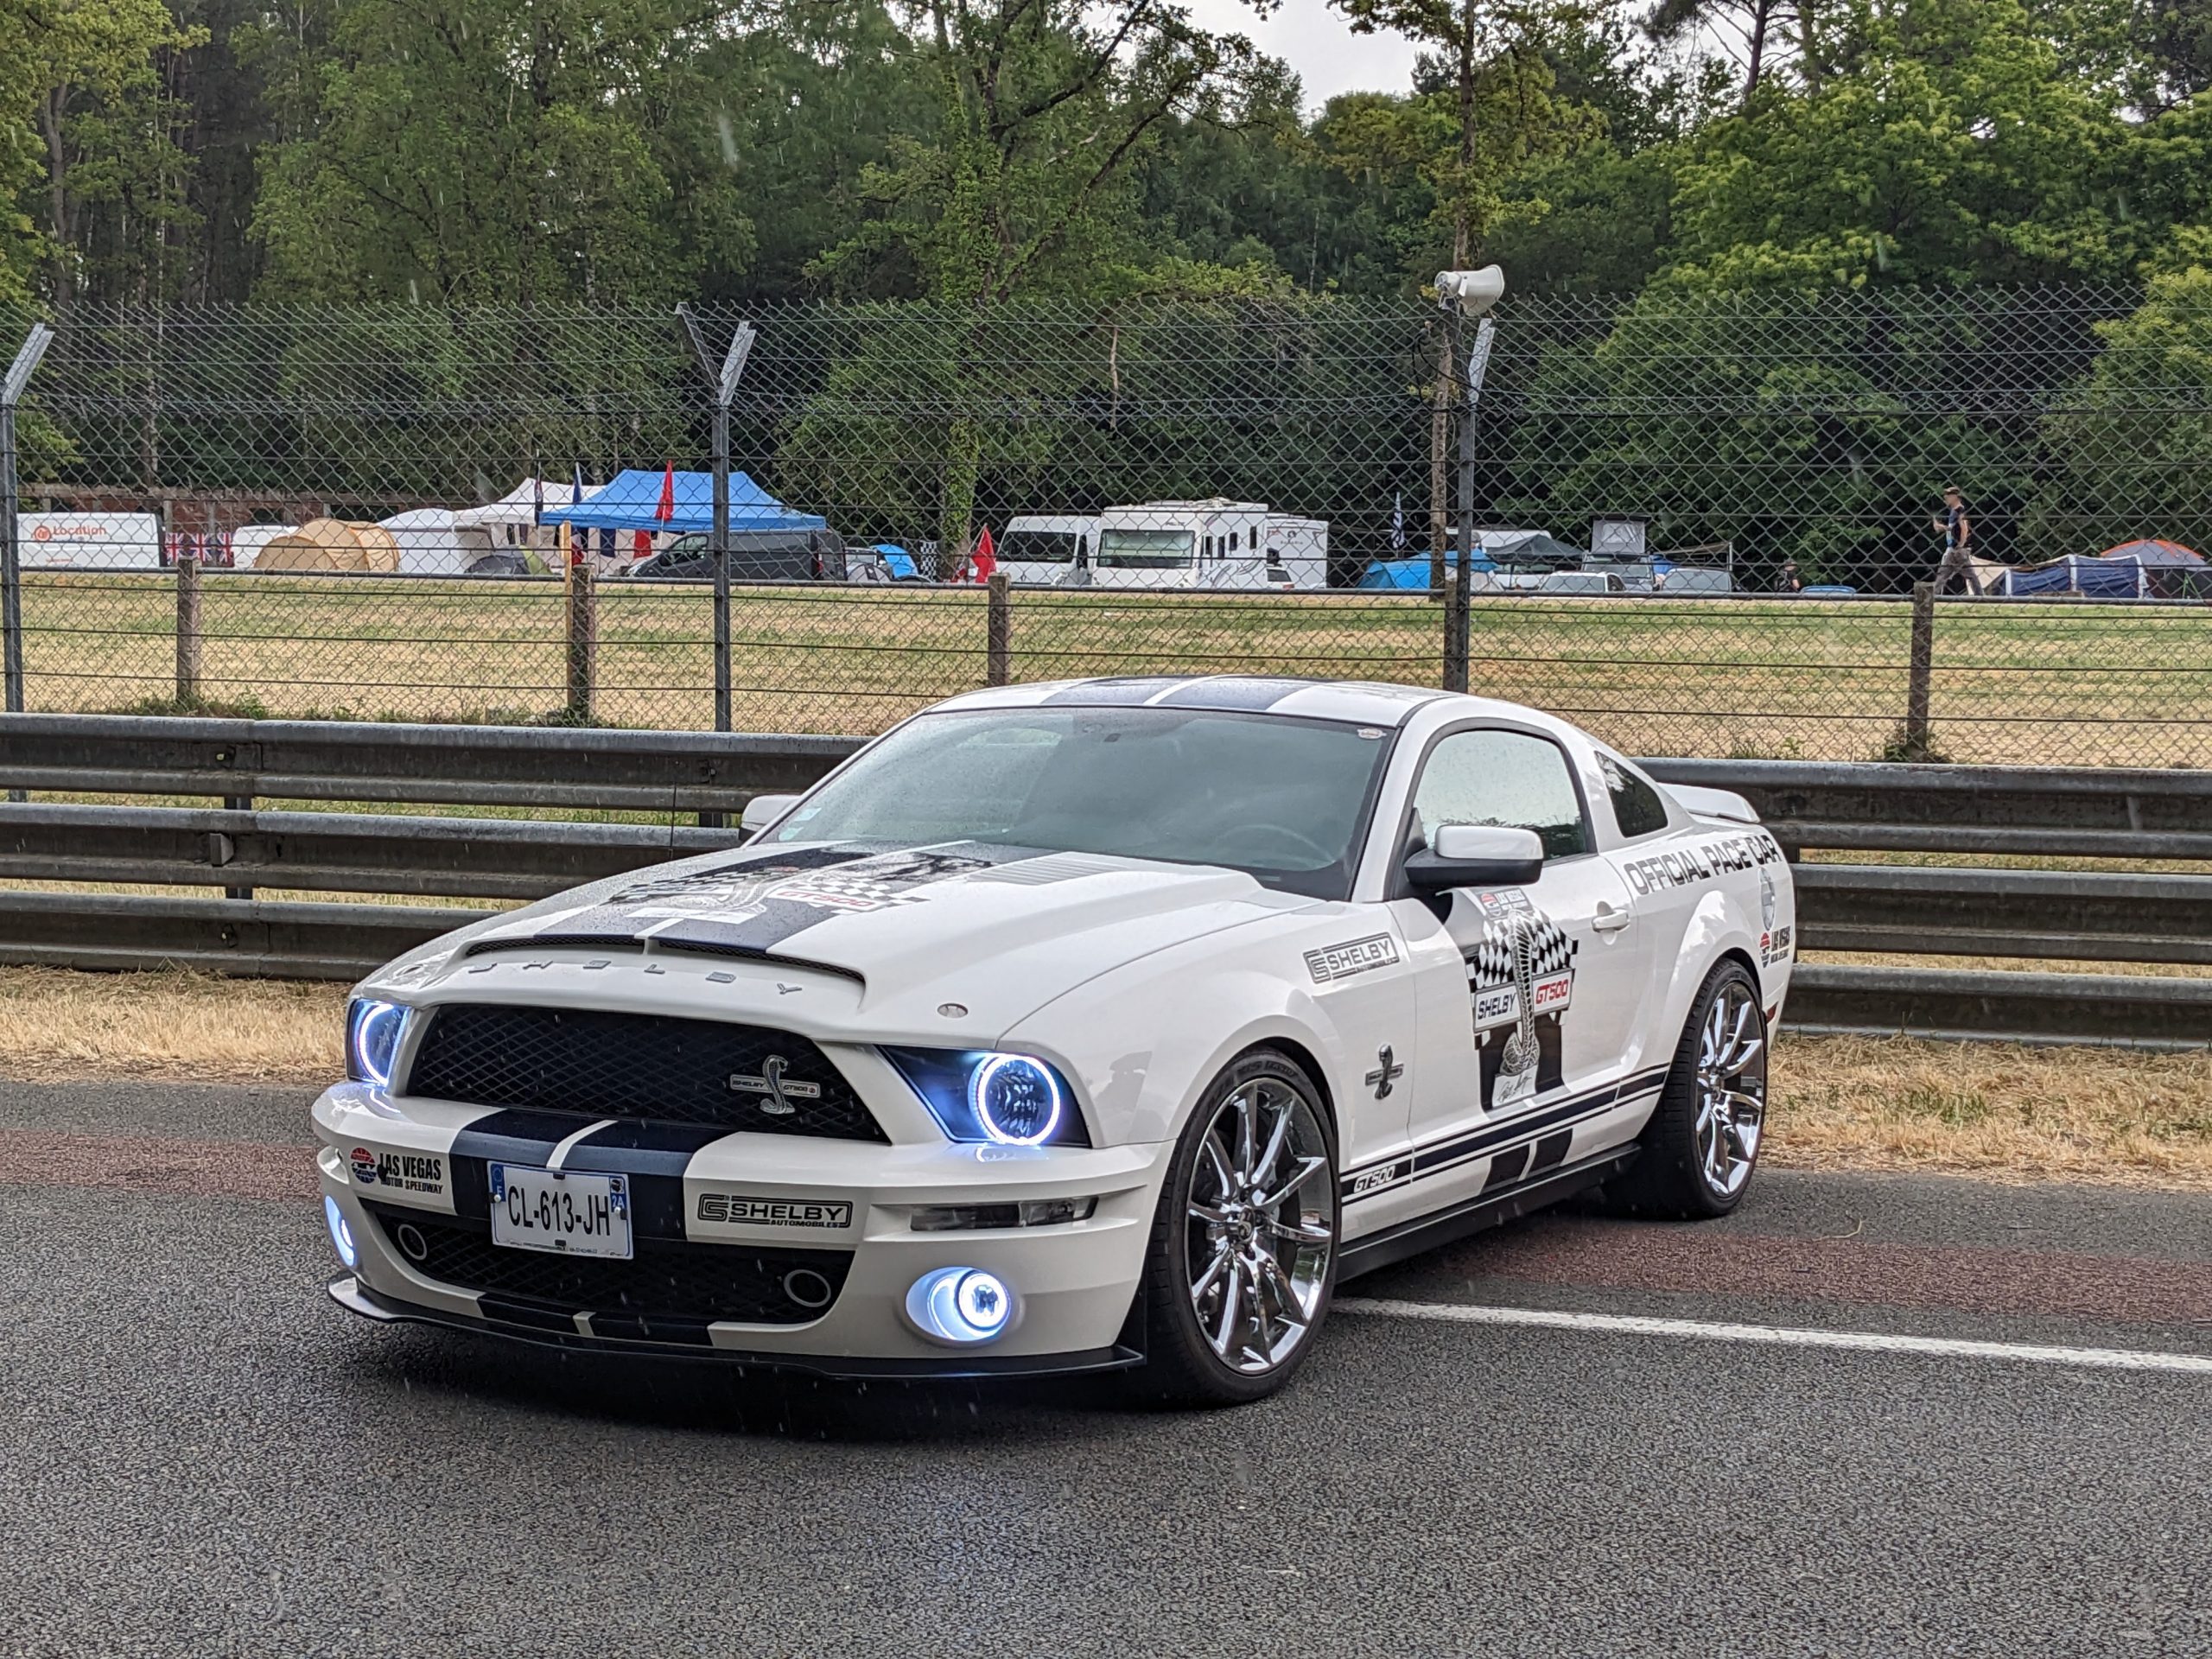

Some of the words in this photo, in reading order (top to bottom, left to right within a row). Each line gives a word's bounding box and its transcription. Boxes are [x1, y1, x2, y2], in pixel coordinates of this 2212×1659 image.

[1624, 849, 1711, 895] OFFICIAL
[1700, 839, 1753, 876] PACE
[1746, 835, 1782, 866] CAR
[779, 891, 874, 906] GT500
[1326, 940, 1390, 970] SHELBY
[468, 960, 803, 995] SHELBY
[1478, 992, 1516, 1020] SHELBY
[1535, 978, 1569, 1004] GT500
[379, 1153, 400, 1176] LAS
[401, 1155, 442, 1181] VEGAS
[1354, 1164, 1396, 1193] GT500
[405, 1179, 444, 1195] SPEEDWAY
[507, 1185, 611, 1236] CL-613-JH
[612, 1194, 626, 1210] 2A
[730, 1202, 844, 1221] SHELBY
[769, 1219, 840, 1229] AUTOMOBILES
